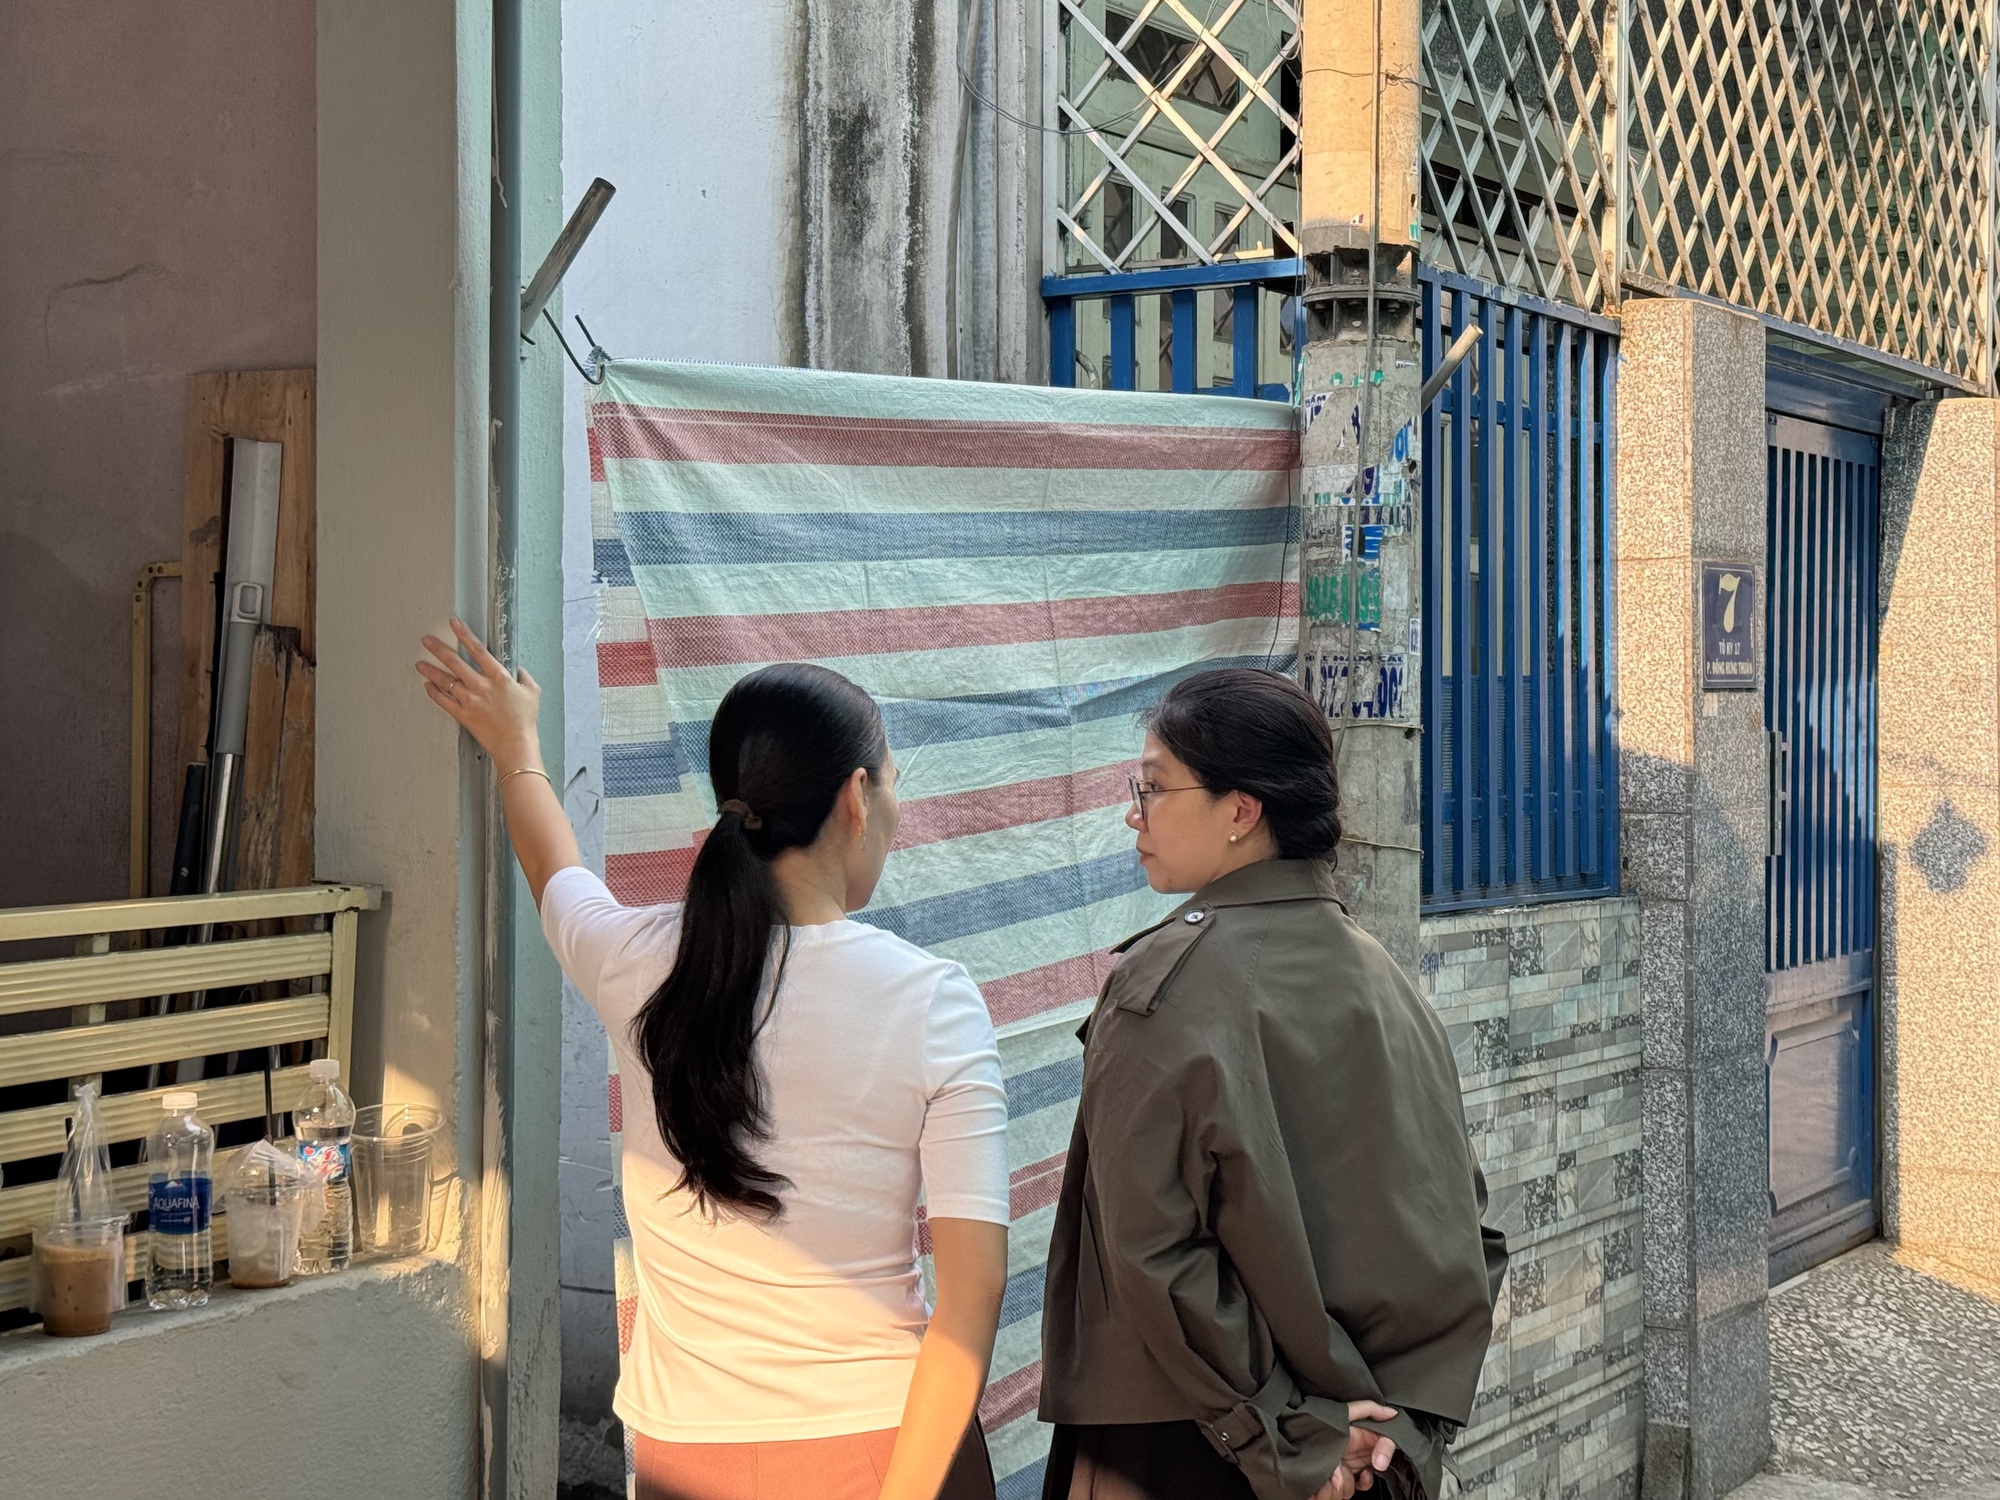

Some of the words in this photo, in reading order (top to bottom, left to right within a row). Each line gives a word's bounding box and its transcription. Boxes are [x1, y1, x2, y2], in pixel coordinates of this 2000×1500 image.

[1719, 574, 1740, 633] 7
[1706, 661, 1712, 675] P.
[154, 1196, 200, 1211] AQUAFINA
